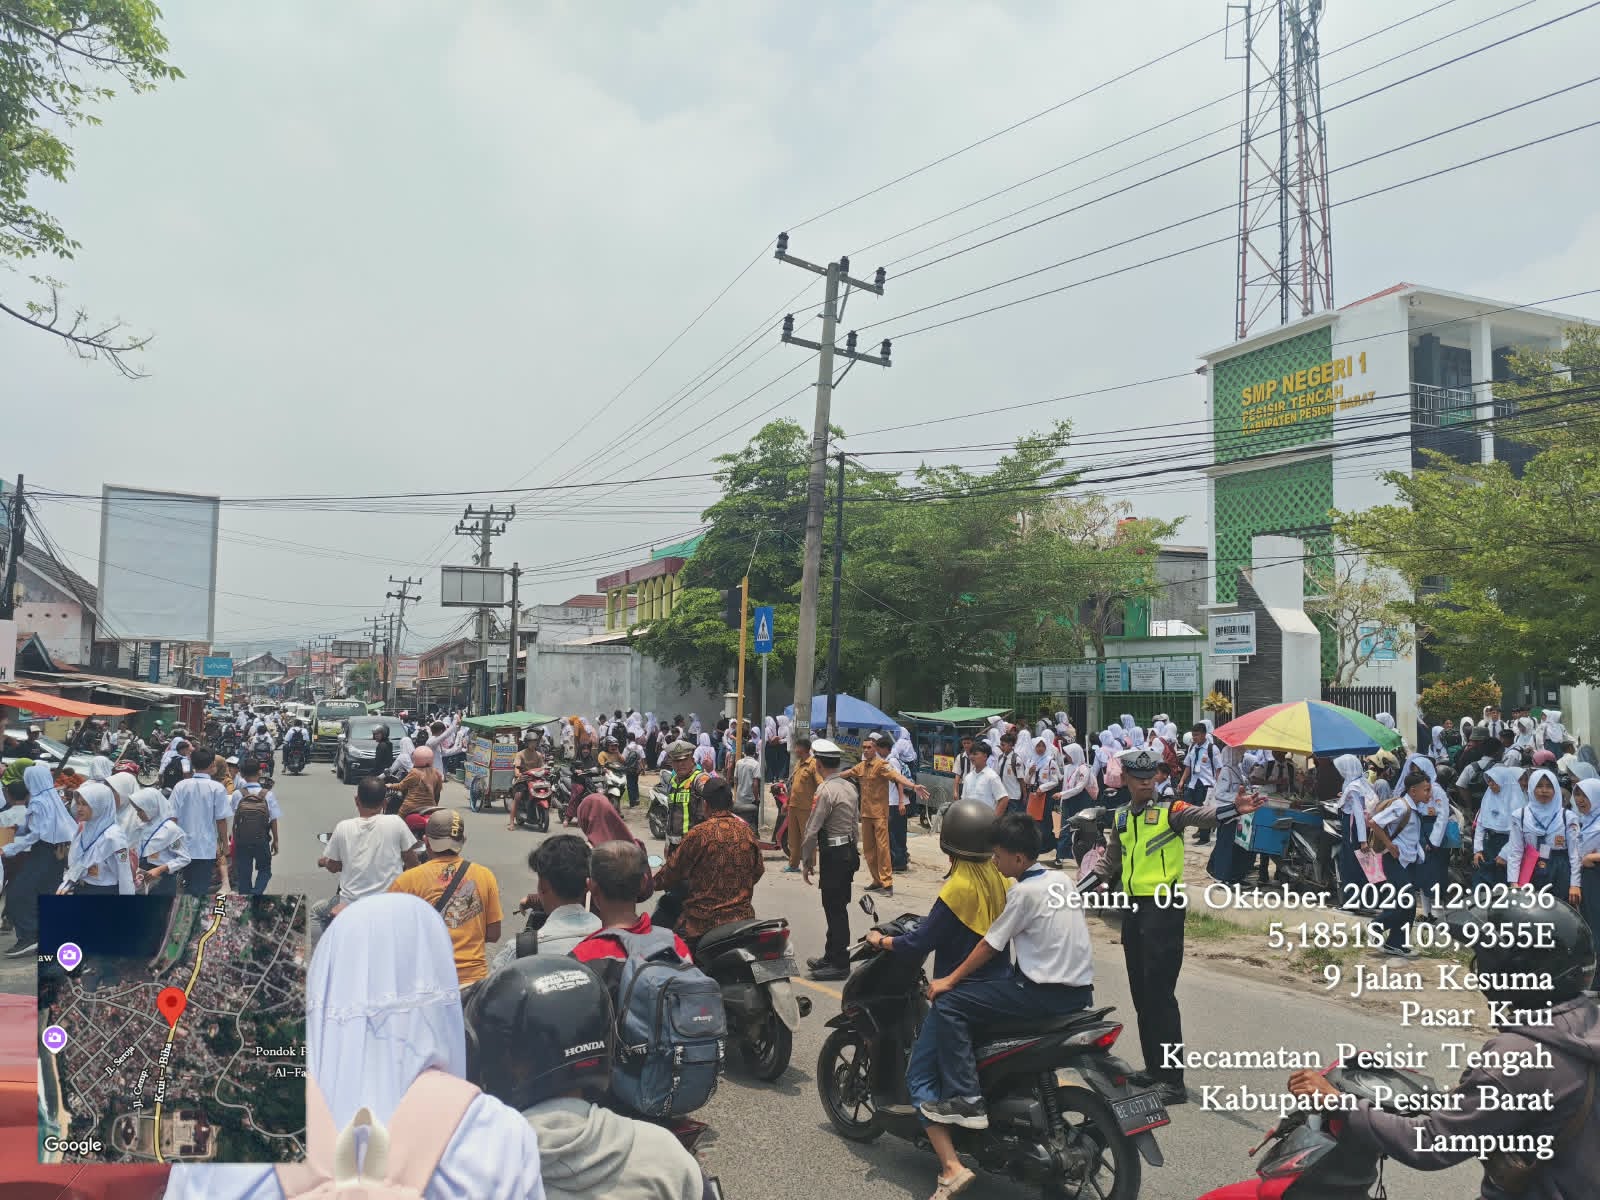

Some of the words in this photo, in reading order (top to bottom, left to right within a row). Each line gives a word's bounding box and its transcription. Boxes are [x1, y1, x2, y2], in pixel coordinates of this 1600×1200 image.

[1241, 379, 1277, 407] SMP
[1282, 355, 1353, 395] NEGERI
[1358, 351, 1367, 374] 1
[1241, 400, 1286, 423] PESISIR
[1242, 411, 1298, 436] KABUPATEN
[564, 1040, 606, 1057] HONDA
